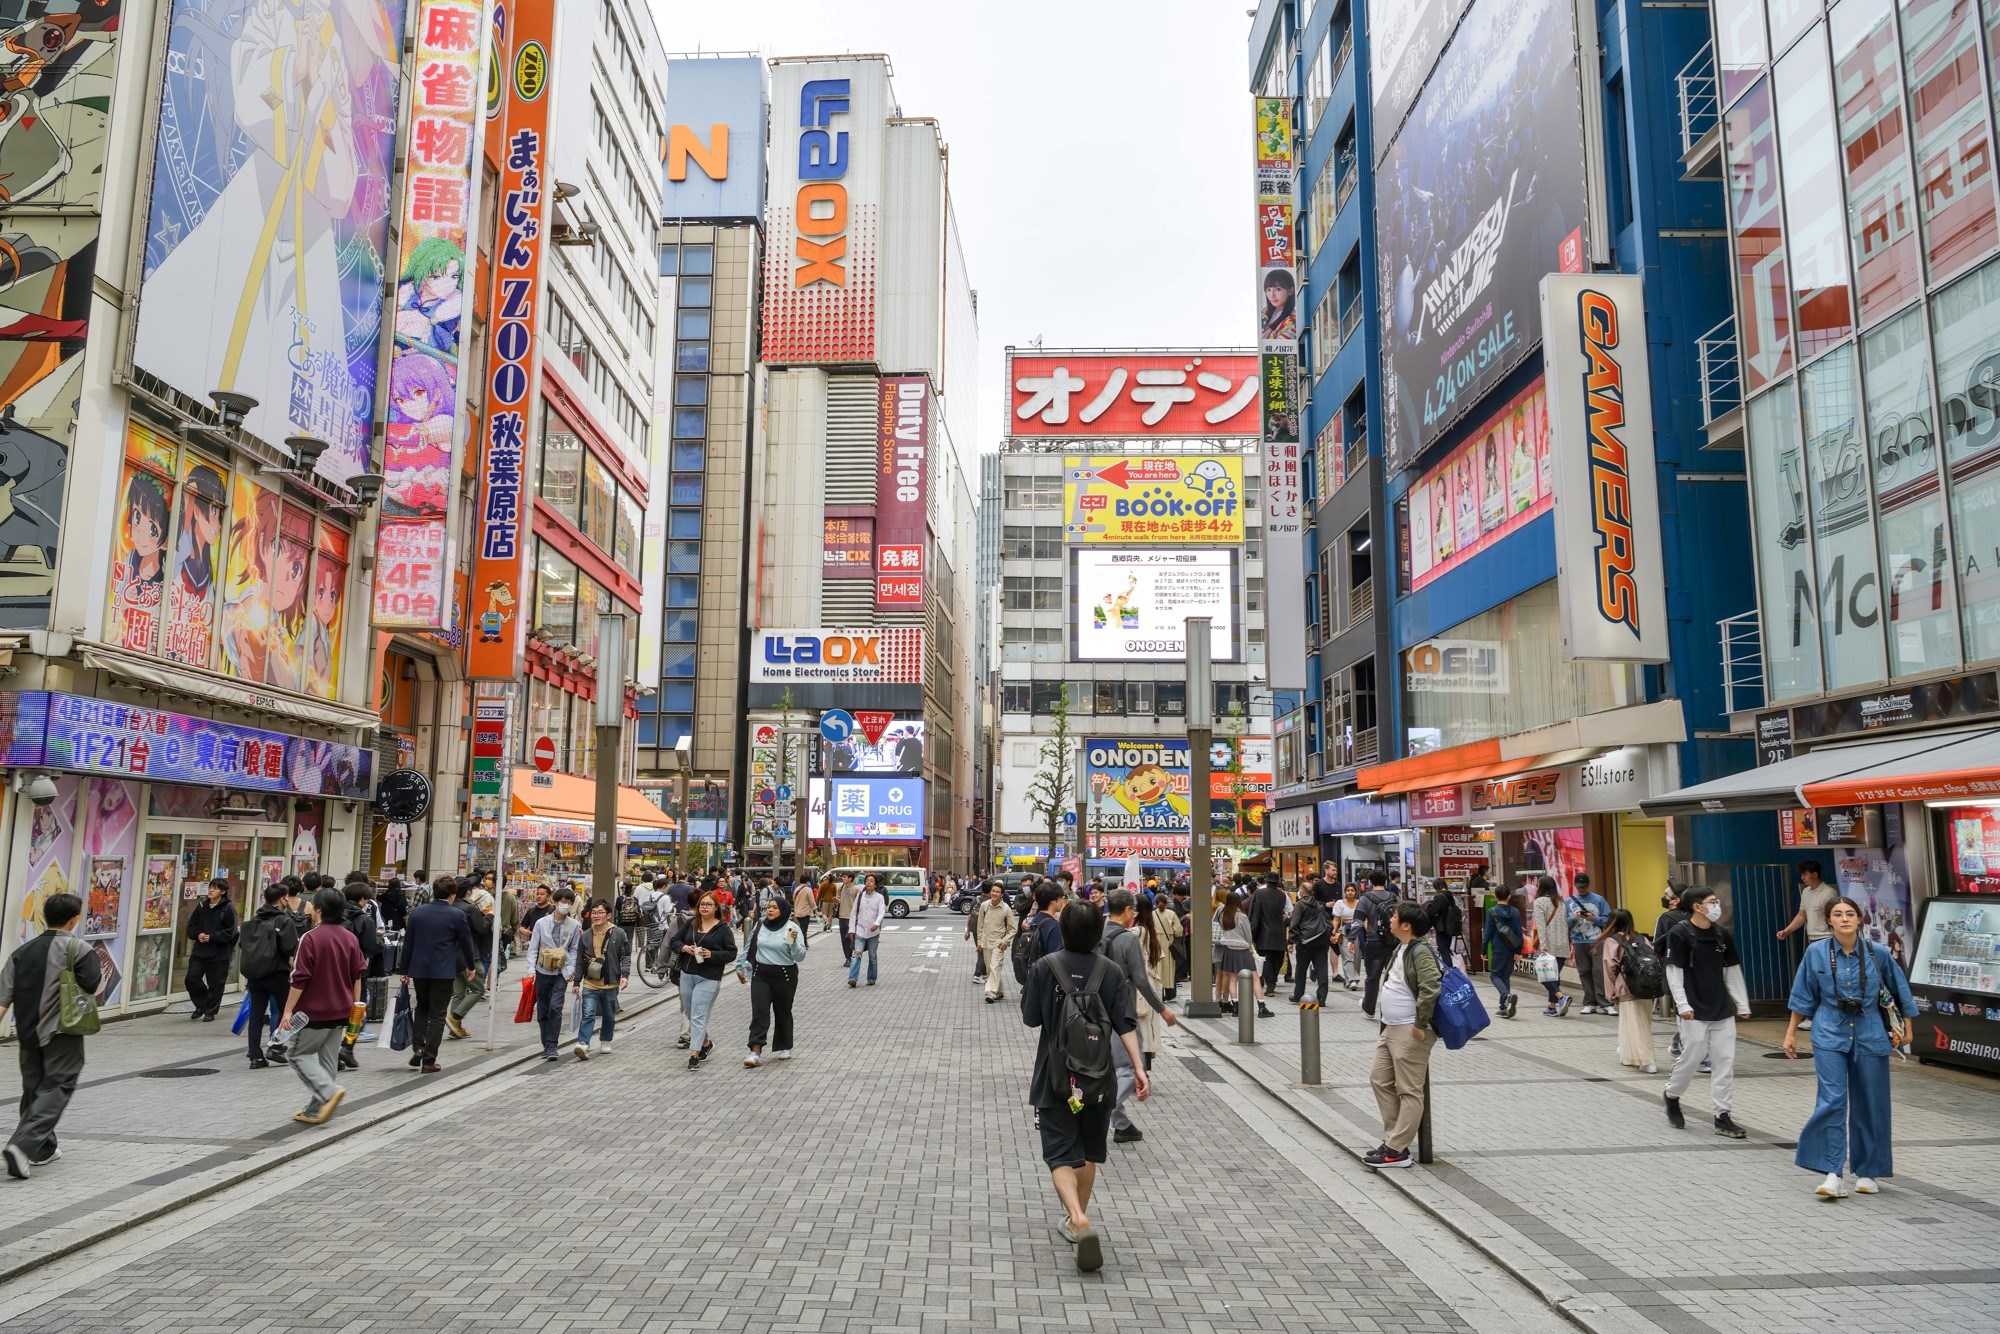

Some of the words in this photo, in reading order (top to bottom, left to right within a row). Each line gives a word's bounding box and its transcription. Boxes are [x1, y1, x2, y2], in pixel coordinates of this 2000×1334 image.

[523, 51, 538, 94] ZOO
[413, 7, 476, 223] 麻雀物語
[663, 123, 729, 181] N
[1259, 180, 1292, 194] 麻雀
[501, 130, 539, 268] まぁじゃん
[289, 305, 317, 334] スマスロ
[494, 279, 530, 404] ZOO
[287, 321, 371, 418] とある魔術の
[1423, 364, 1456, 425] 4.24
[1456, 349, 1476, 388] ON
[1478, 309, 1515, 369] SALE
[1015, 357, 1258, 424] オノデン
[288, 371, 364, 463] 禁書目録
[881, 383, 896, 435] Flagship
[896, 383, 926, 440] Duty
[883, 439, 895, 474] Store
[1143, 461, 1175, 471] 現在地
[1578, 289, 1641, 641] GAMERS
[896, 446, 925, 502] Free
[1284, 445, 1298, 518] 和風耳かき
[483, 412, 524, 558] 秋葉原店
[1082, 498, 1105, 507] ここ!
[382, 527, 443, 541] 4月21日
[825, 520, 848, 531] 本店
[1121, 519, 1233, 533] 現在地から徒歩4分
[825, 533, 871, 544] 総合家電
[882, 550, 919, 567] 免税
[386, 563, 432, 588] 4F
[111, 561, 125, 623] SLOT
[881, 583, 920, 597] 면세점
[378, 593, 436, 616] 10台
[1125, 640, 1185, 652] ONODEN
[763, 667, 791, 677] Home
[795, 667, 849, 677] Electronics
[853, 667, 880, 677] Store
[256, 696, 276, 708] ESPACE
[59, 697, 168, 735] 4月21日新台入替
[477, 708, 505, 717] フロア案
[863, 716, 886, 724] 止まれ
[476, 733, 498, 743] 喫煙
[72, 732, 150, 773] 1F21台
[166, 737, 181, 764] e
[194, 730, 281, 778] 東京喰種
[1090, 749, 1189, 767] ONODEN
[474, 771, 496, 782] 禁煙
[841, 789, 865, 813] 薬
[1471, 773, 1560, 811] GAMERS
[1855, 791, 1866, 800] 1F
[1867, 790, 1875, 798] 2F
[1876, 789, 1885, 798] 3F
[1886, 788, 1896, 797] 4F
[1897, 786, 1919, 797] Card
[1920, 785, 1943, 795] Game
[1944, 784, 1968, 794] Shop
[879, 806, 912, 815] DRUG
[1425, 798, 1455, 813] C-labo
[1130, 836, 1149, 847] TAX
[1151, 836, 1174, 847] FREE
[1442, 833, 1474, 841] TCG専門
[1141, 848, 1185, 857] ONODEN
[1443, 848, 1483, 856] C-labo
